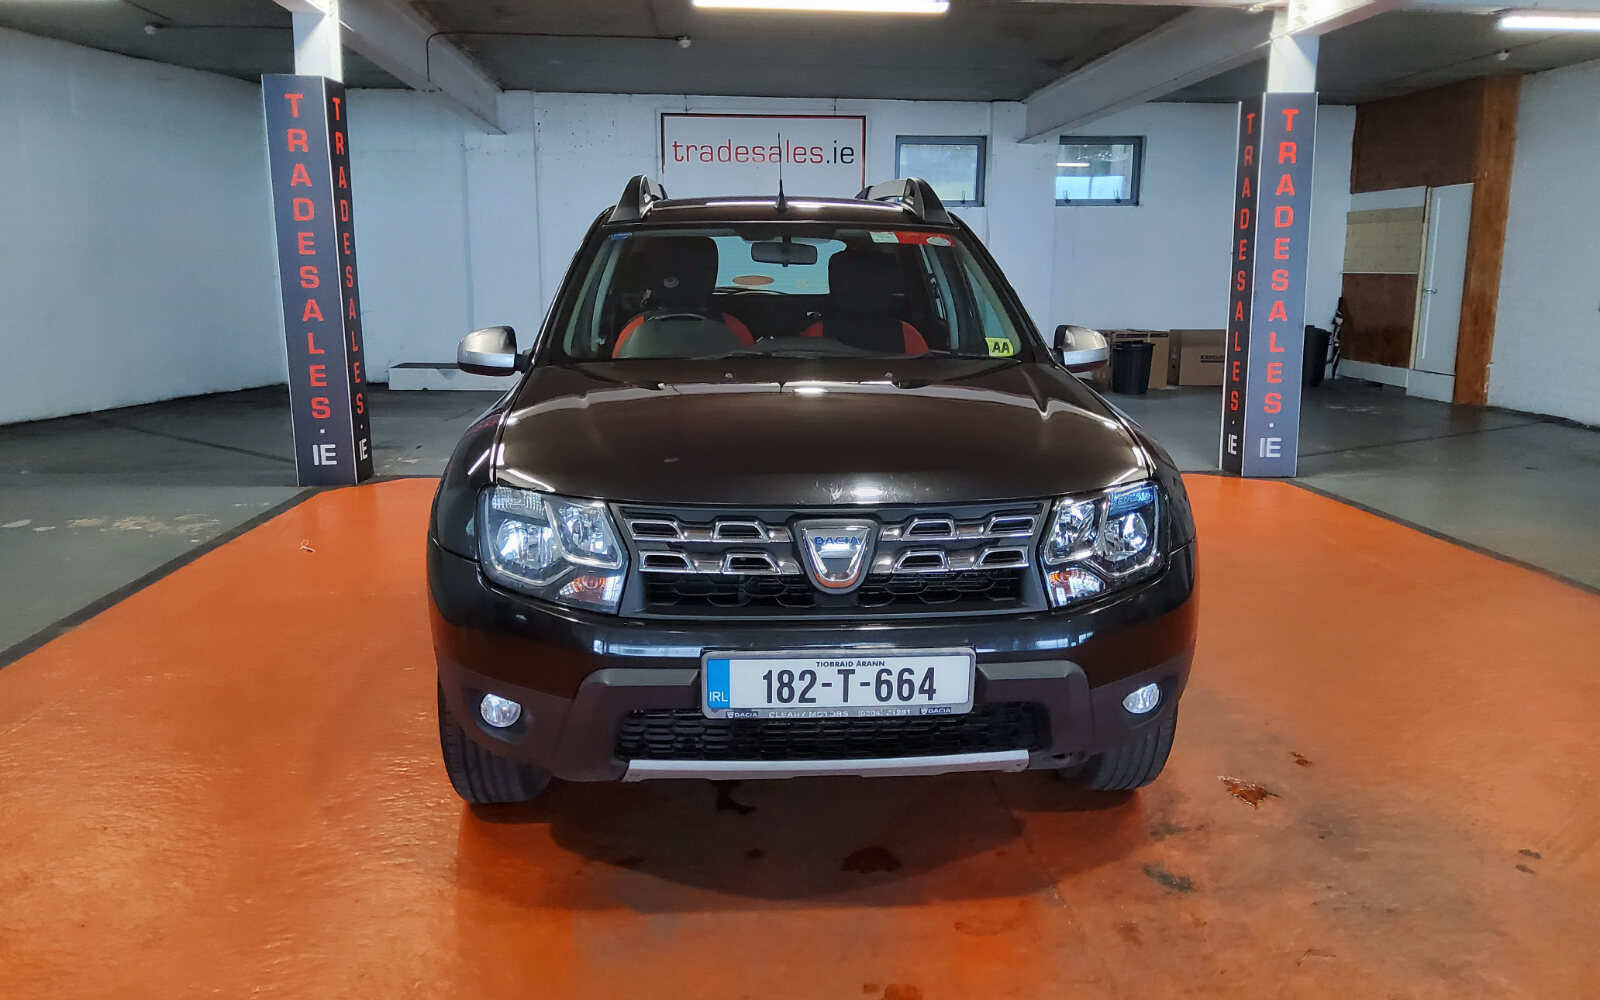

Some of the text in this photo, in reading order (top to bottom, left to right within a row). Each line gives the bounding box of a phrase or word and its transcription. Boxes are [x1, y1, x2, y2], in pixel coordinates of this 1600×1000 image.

[671, 139, 855, 165] tradesales.ie
[992, 341, 1010, 353] AA
[813, 536, 859, 545] DACIA
[816, 660, 854, 668] TIOBRAID
[762, 666, 937, 704] 182-T-664
[709, 691, 729, 702] IRL
